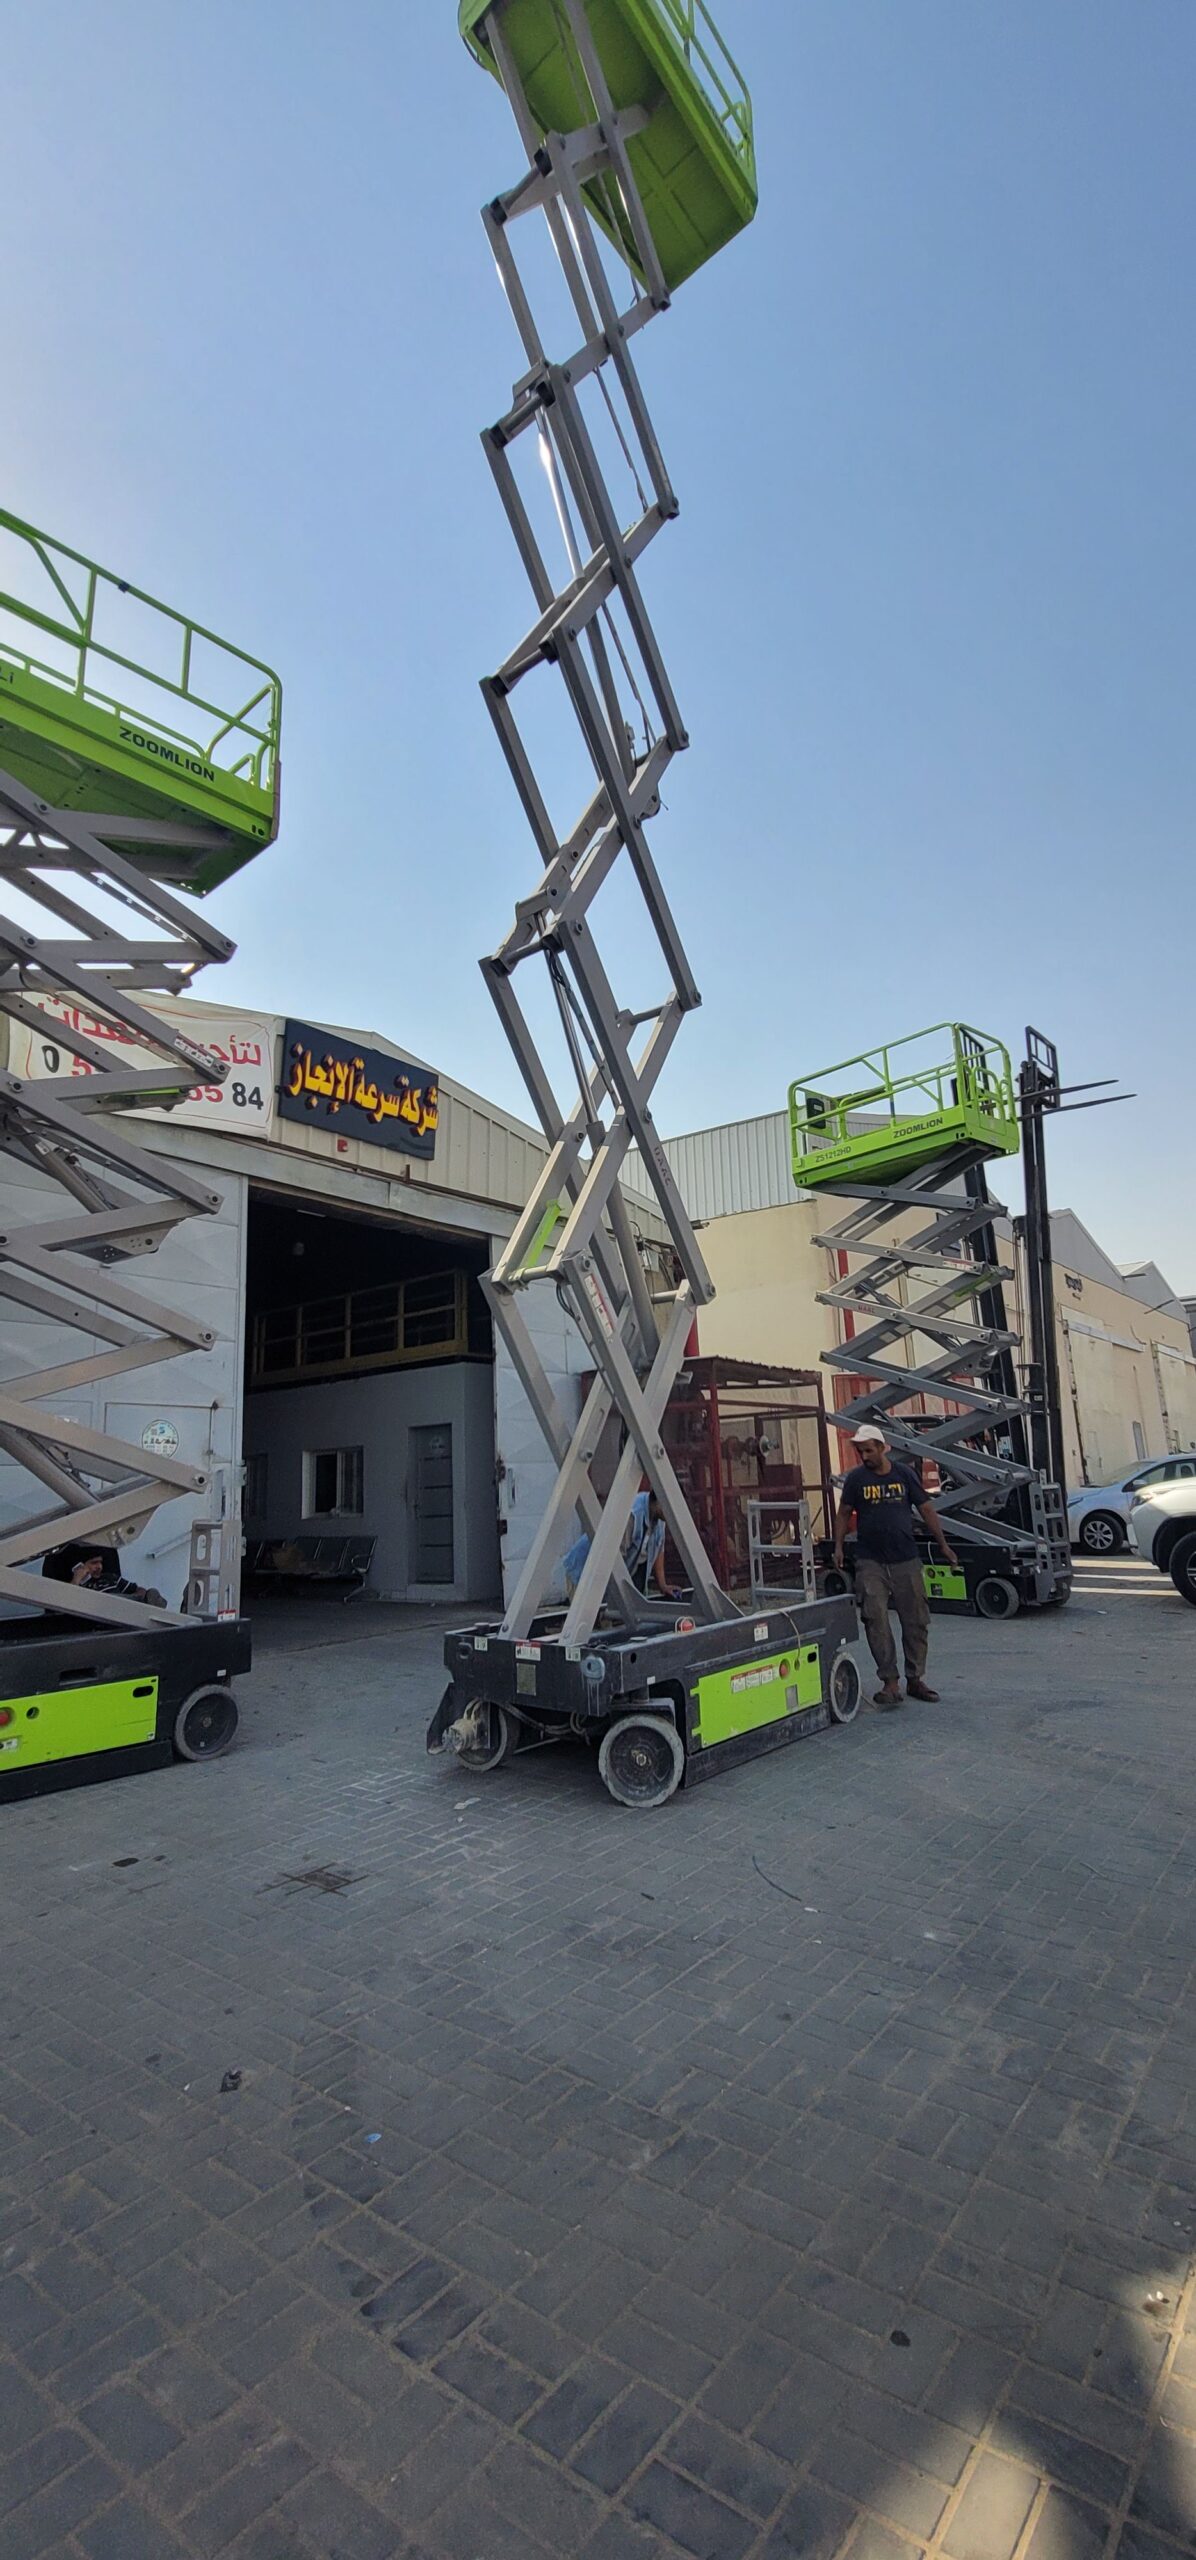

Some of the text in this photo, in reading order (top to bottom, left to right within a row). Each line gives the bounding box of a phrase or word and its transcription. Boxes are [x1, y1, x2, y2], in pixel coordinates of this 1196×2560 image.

[119, 726, 215, 782] ZOOMLION
[232, 1082, 264, 1110] 84
[353, 1056, 400, 1123] سرعة
[399, 1074, 439, 1136] شركة
[893, 1117, 943, 1139] ZOOMLION
[815, 1145, 852, 1163] ZS1212HD
